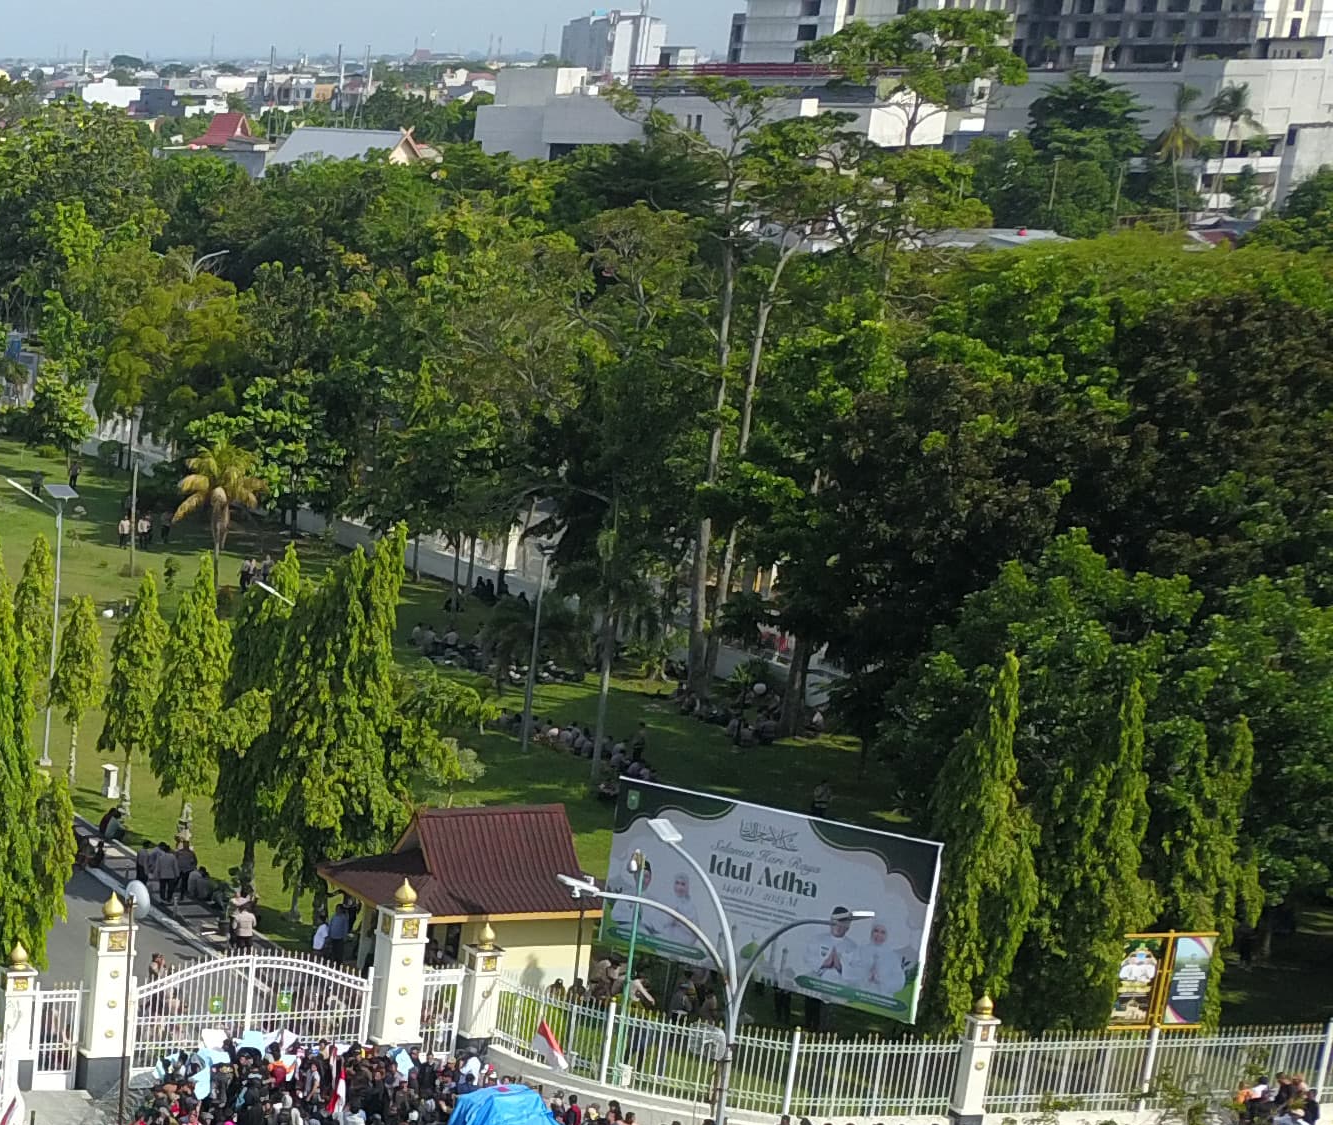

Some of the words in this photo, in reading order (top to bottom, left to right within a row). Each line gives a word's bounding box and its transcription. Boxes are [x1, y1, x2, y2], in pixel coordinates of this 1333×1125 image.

[709, 839, 756, 858] Selamat
[756, 850, 785, 864] Hari
[789, 856, 821, 875] Raya
[709, 854, 753, 882] Idul
[757, 866, 817, 898] Adha
